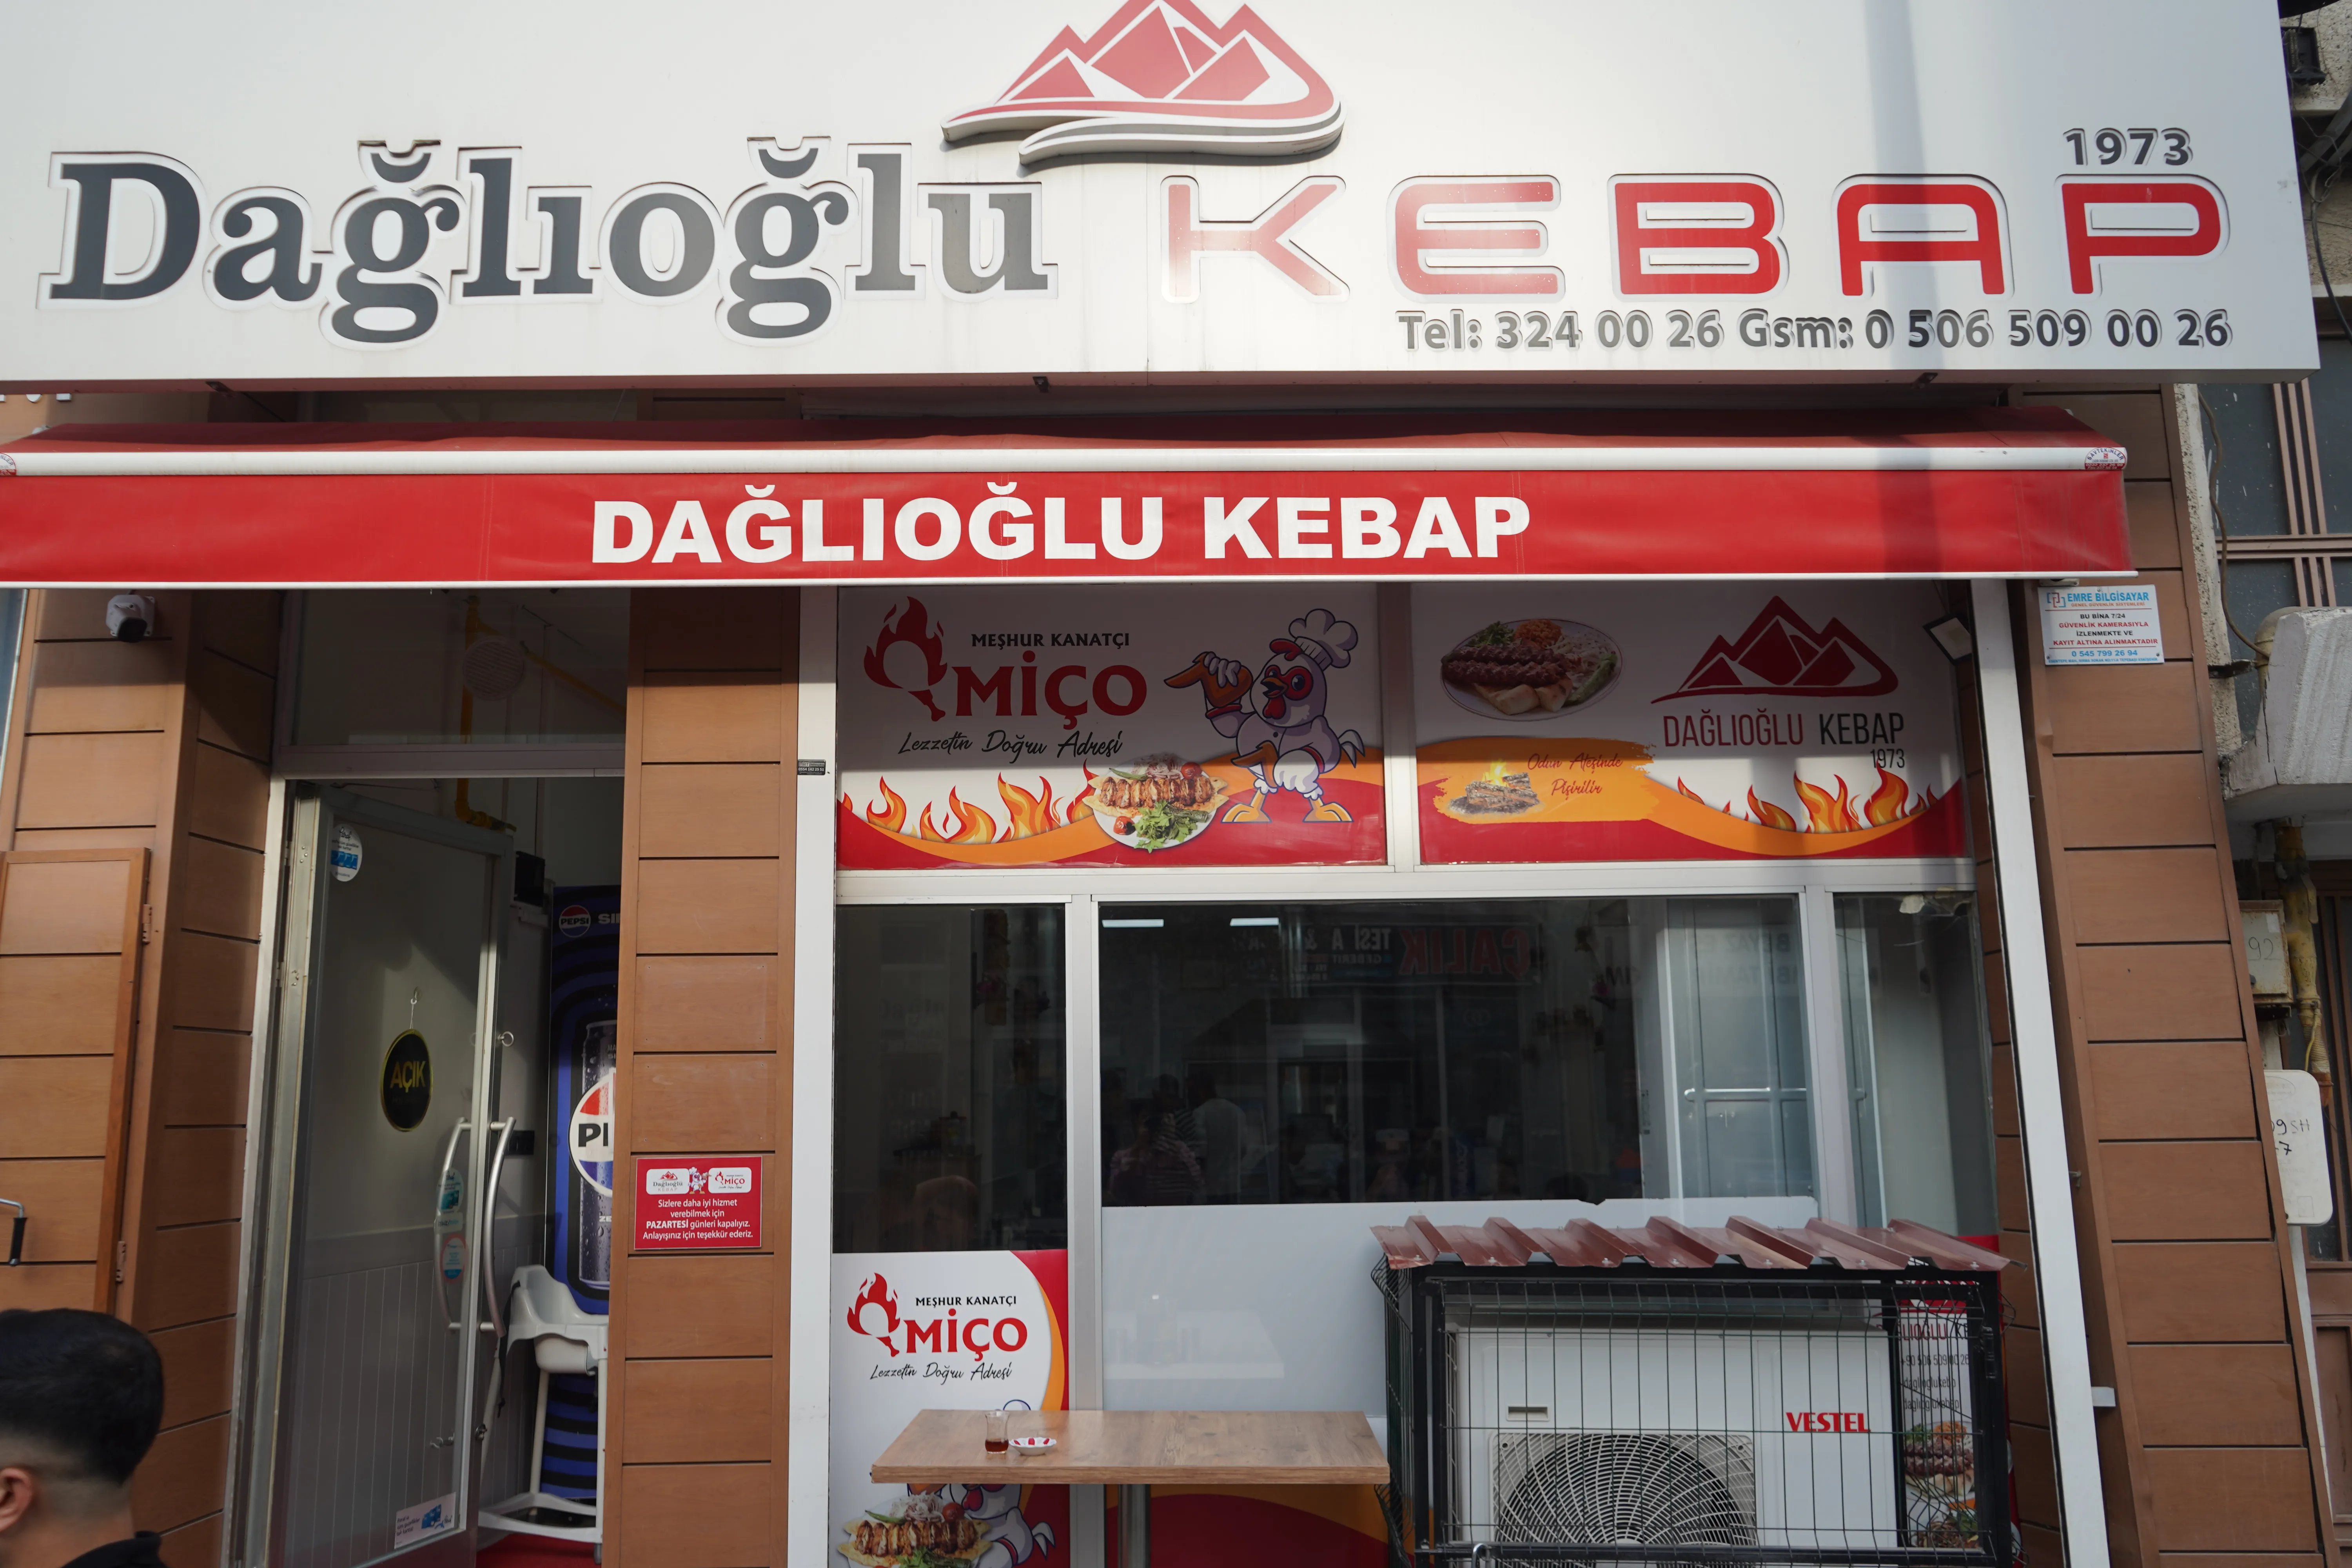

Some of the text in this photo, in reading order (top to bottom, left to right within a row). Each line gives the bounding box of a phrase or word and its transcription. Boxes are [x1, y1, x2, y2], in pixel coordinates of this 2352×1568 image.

[2064, 131, 2191, 166] 1973
[46, 145, 2222, 345] Dağlıoğlu KEBAP
[1398, 312, 2231, 350] Tel: 324 00 26 Gsm: 0 506 509 00 26
[591, 481, 1531, 564] DAĞLIOĞLU KEBAP
[2067, 593, 2092, 602] EMRE
[971, 632, 1129, 651] MEŞHUR KANATÇI
[951, 650, 1147, 730] MİÇO
[1662, 708, 1905, 747] DAĞLIOĞLU KEBAP
[898, 730, 1123, 764] Lezzetin Doğru Adresi
[1527, 751, 1623, 774] Odun Ateşinde
[1869, 748, 1906, 769] 1973
[1551, 778, 1602, 800] Pişirilir
[561, 917, 589, 926] PEPSI
[389, 1061, 426, 1093] AÇIK
[724, 1177, 745, 1185] MİÇO
[658, 1198, 738, 1209] Sizlere daha iyi hizmet
[670, 1209, 724, 1219] verebilmek için
[646, 1219, 750, 1230] PAZARTESİ günleri kapalıyız.
[642, 1230, 753, 1241] Anlayışınız için teşekkür ederiz.
[915, 1296, 1017, 1308] MEŞHUR KANATÇI
[903, 1308, 1028, 1362] MİÇO
[1933, 1354, 1947, 1366] 509
[869, 1361, 1013, 1385] Lezzetin Doğru Adresi
[1786, 1412, 1871, 1433] VESTEL
